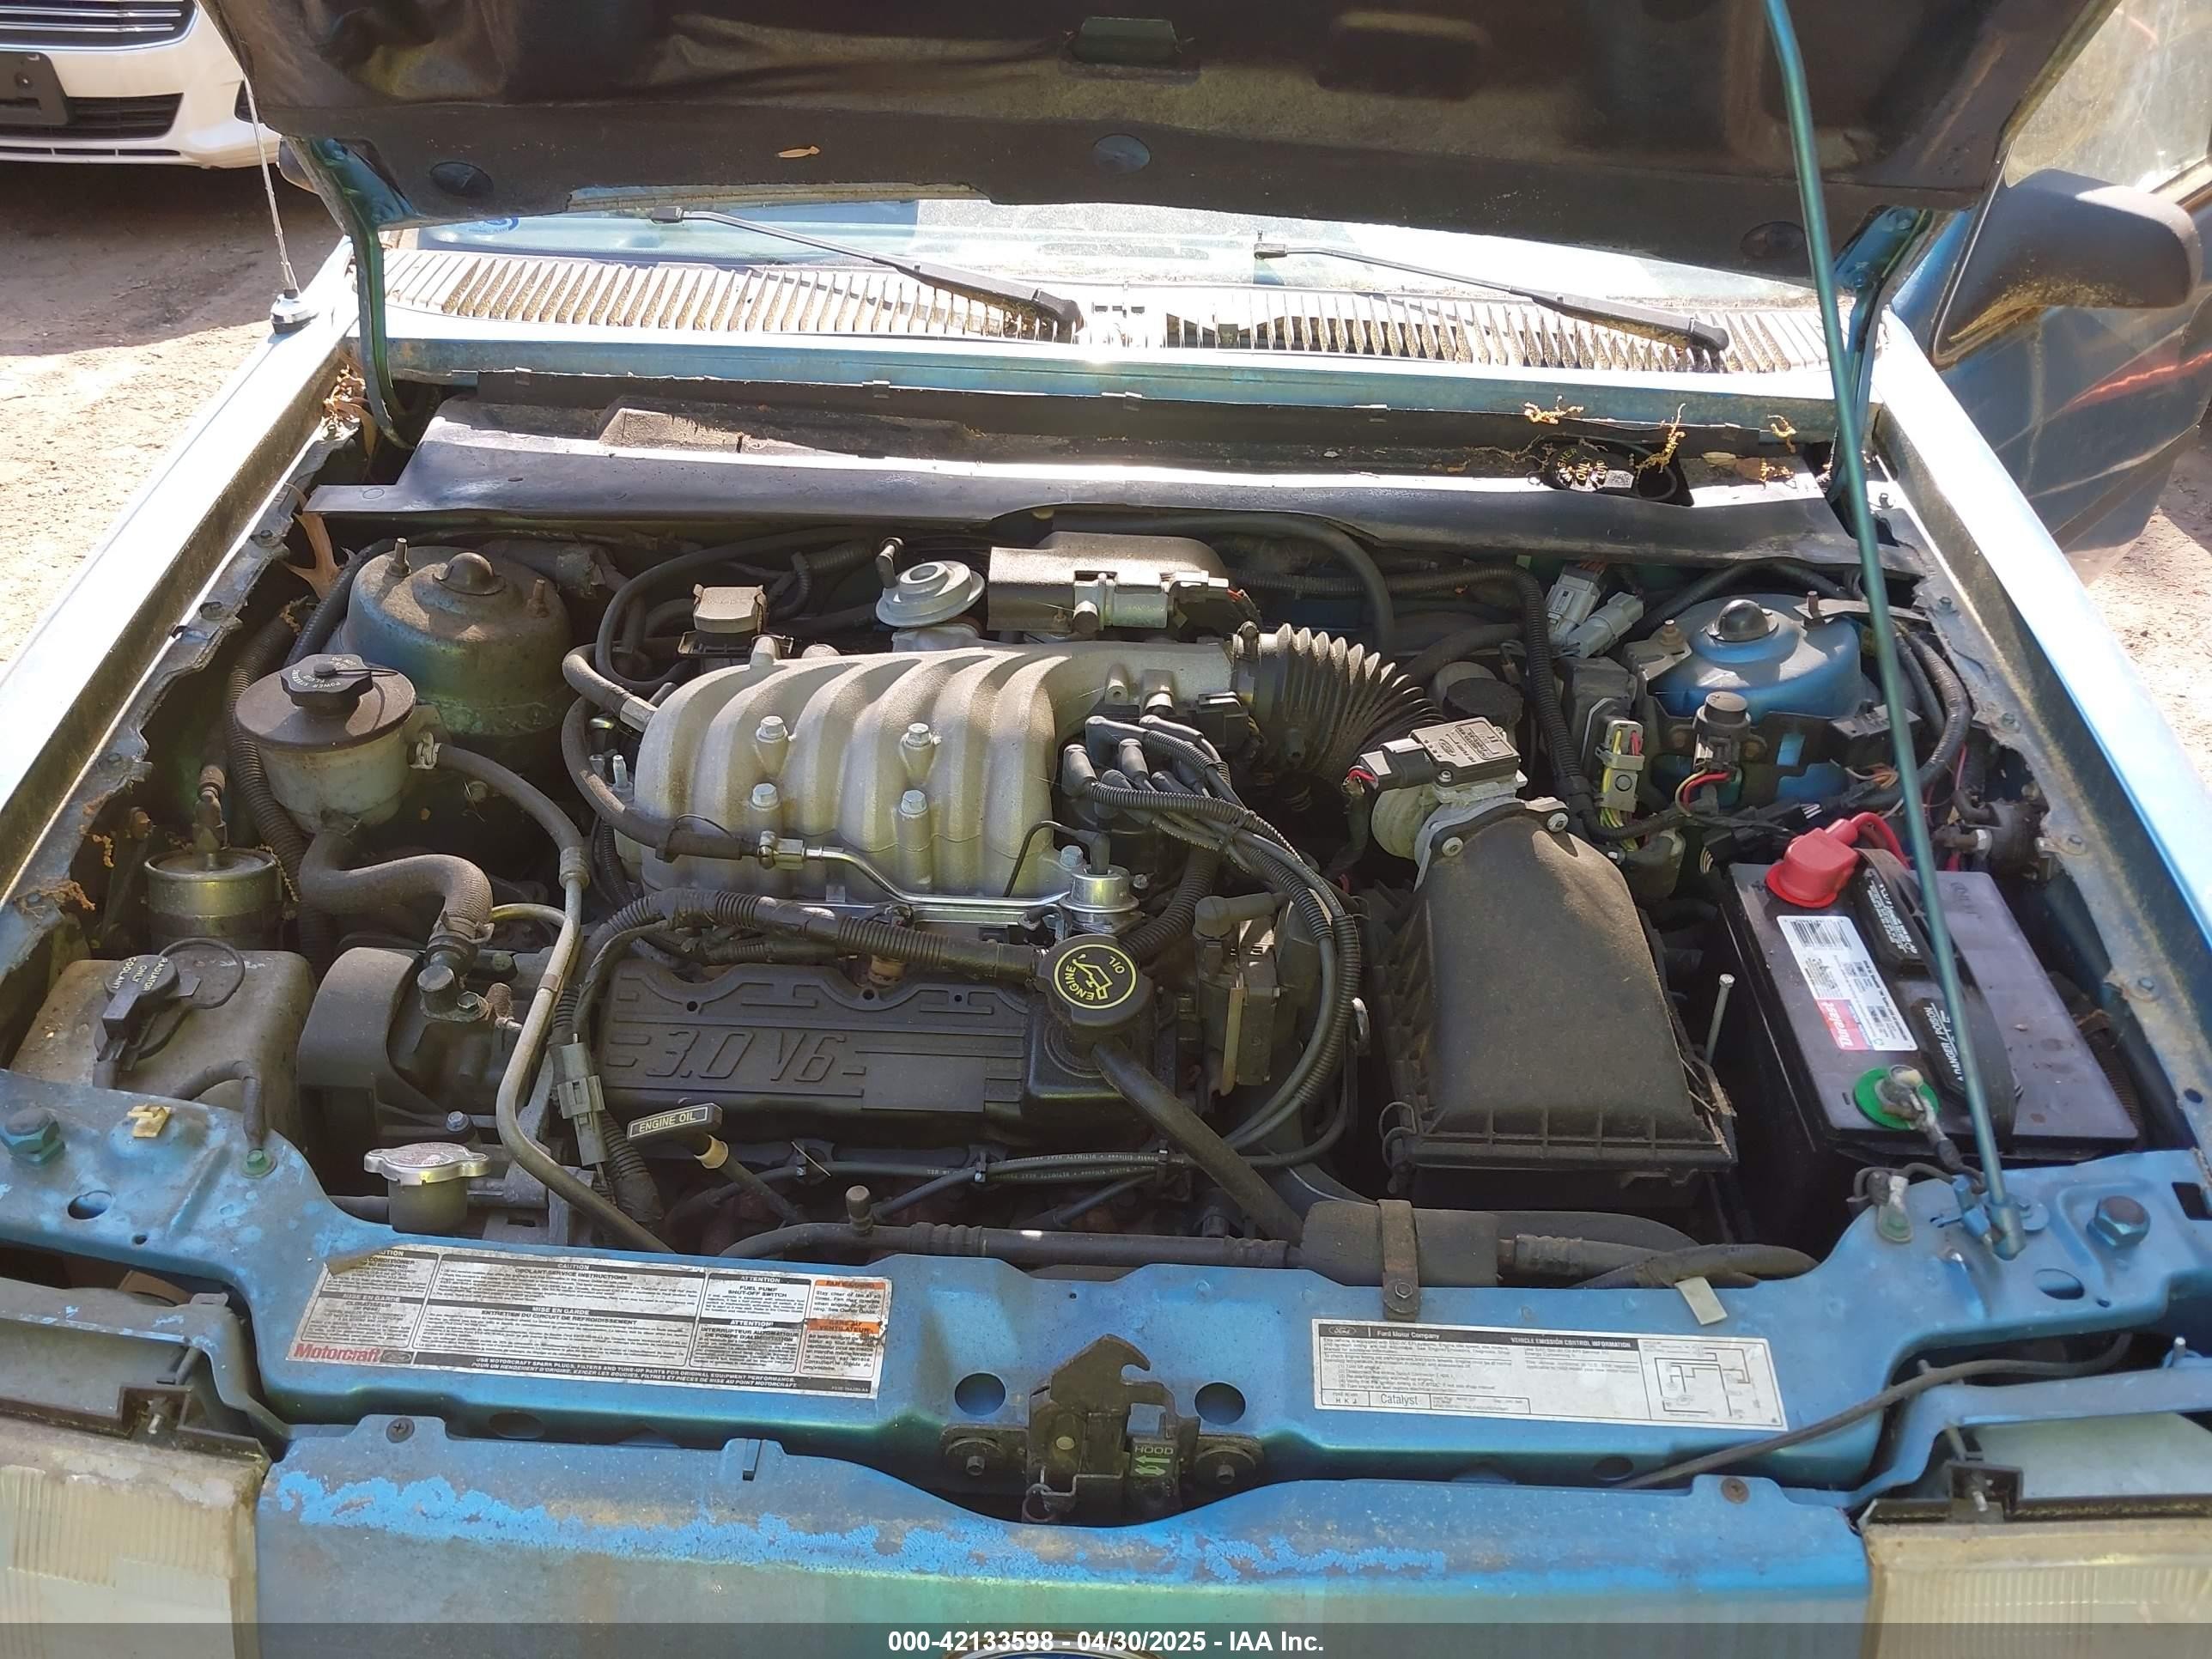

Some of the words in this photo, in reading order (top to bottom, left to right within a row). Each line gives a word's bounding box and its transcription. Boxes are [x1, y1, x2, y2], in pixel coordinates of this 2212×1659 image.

[1577, 455, 1593, 480] ONLY
[112, 957, 137, 990] COOLANT
[132, 965, 148, 982] ONLY
[143, 957, 168, 991] RADIATOR
[1065, 965, 1094, 1001] ENGINE
[1109, 955, 1125, 974] OIL
[1821, 1001, 1853, 1047] Duralast
[1923, 1007, 1946, 1035] POISON
[646, 1030, 756, 1079] 3.0
[771, 1032, 846, 1082] V6
[639, 1116, 675, 1133] ENGINE
[679, 1112, 696, 1122] OIL
[1411, 1332, 1440, 1340] Company
[294, 1343, 380, 1362] Motorcraft
[488, 1357, 531, 1366] MOTORCRAFT
[1381, 1393, 1418, 1406] Catalyst
[1134, 1445, 1174, 1455] HOOD
